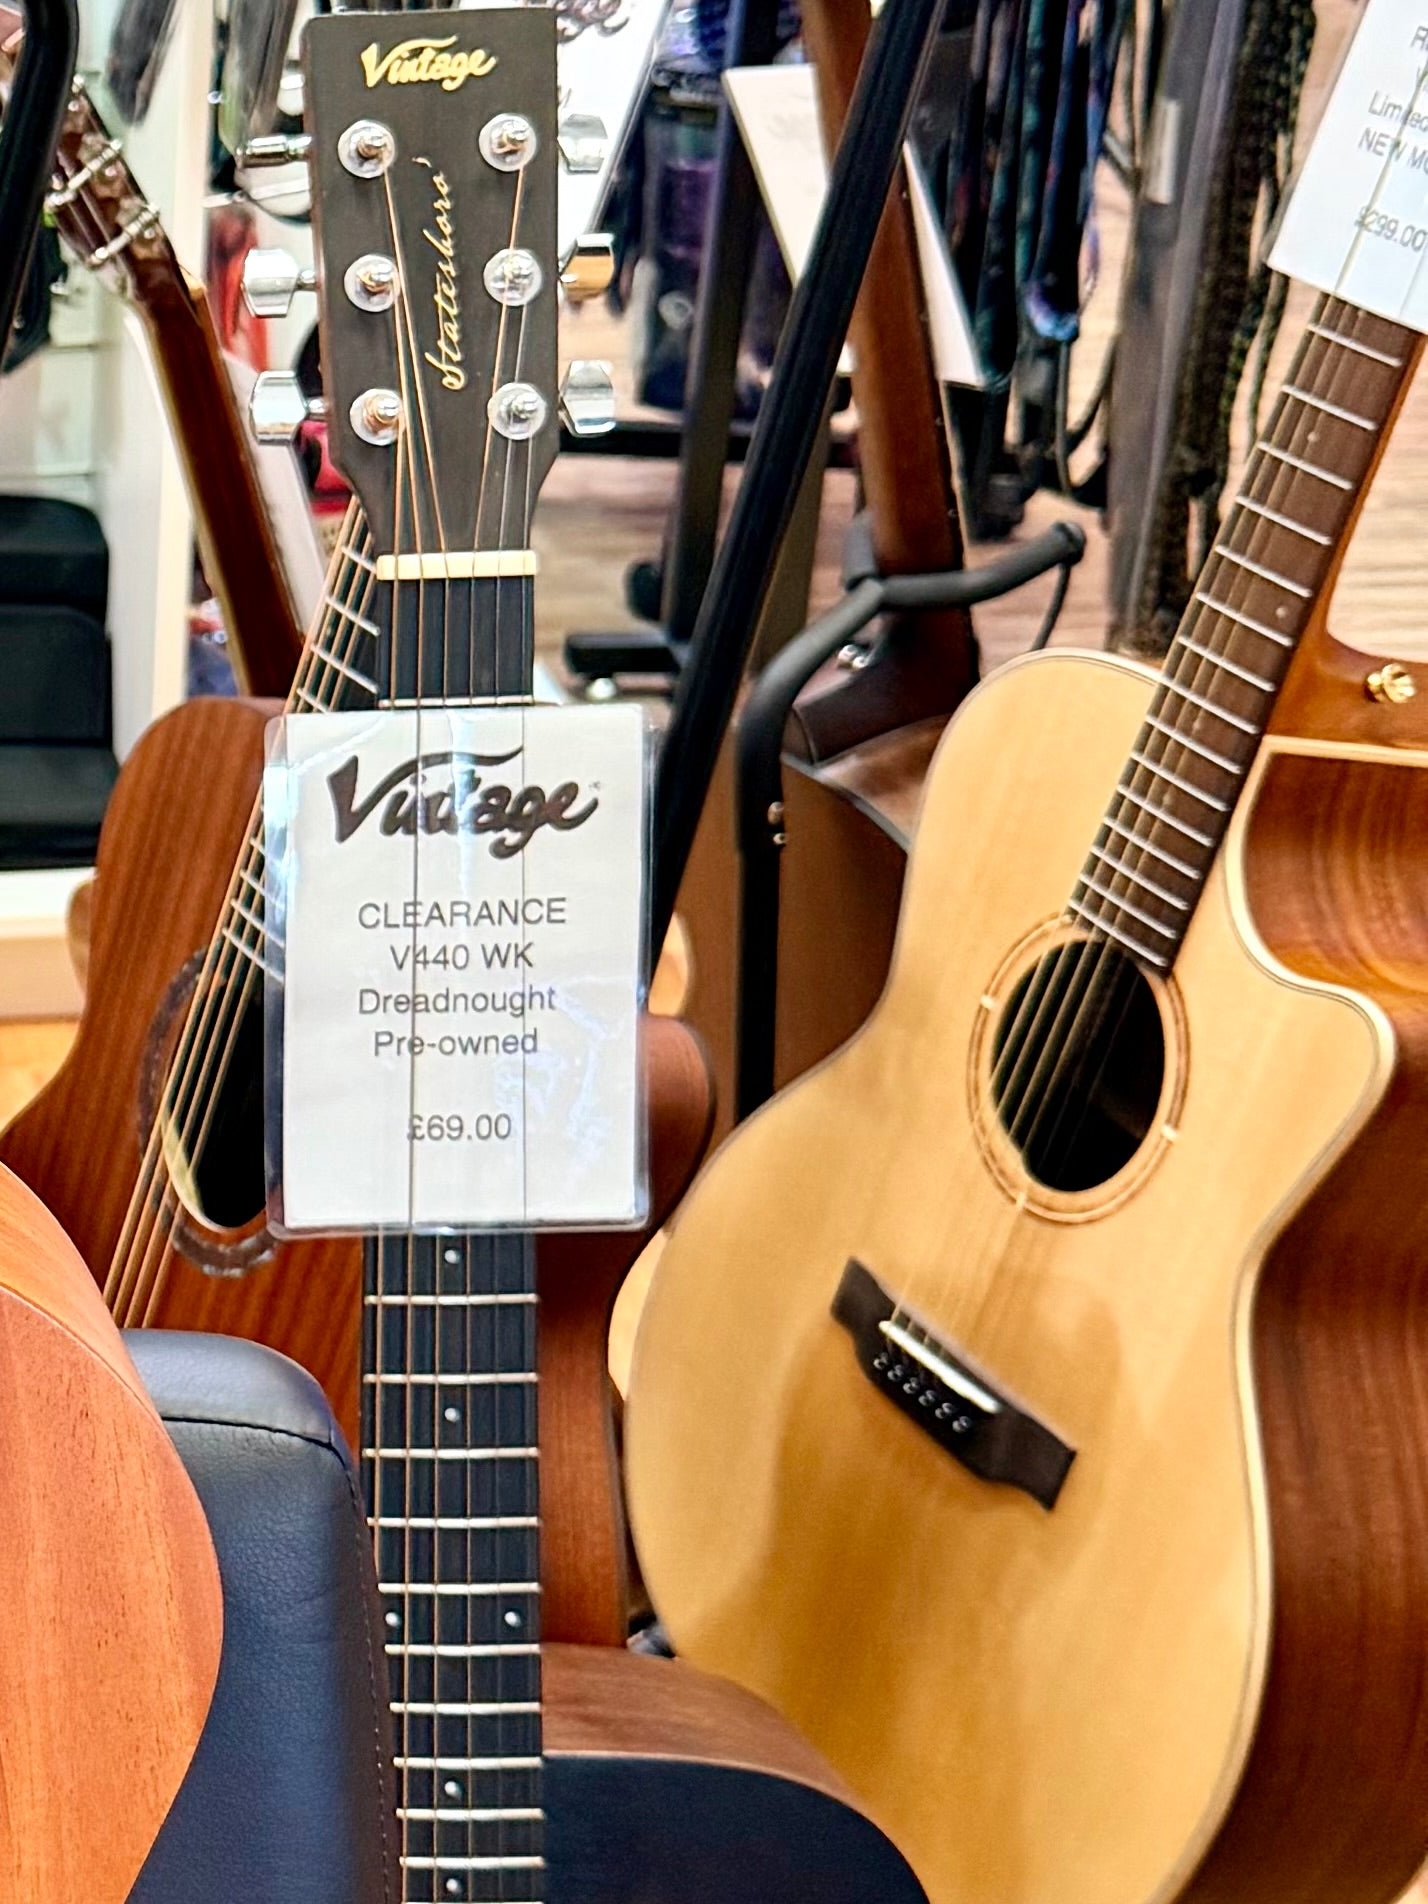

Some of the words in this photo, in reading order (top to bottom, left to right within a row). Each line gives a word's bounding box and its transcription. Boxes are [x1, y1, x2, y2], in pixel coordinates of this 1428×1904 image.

[359, 34, 498, 92] Vintage
[327, 744, 600, 860] Vintage
[358, 897, 568, 930] CLEARANCE
[390, 944, 471, 972] V440
[479, 942, 535, 971] WK
[358, 986, 557, 1019] Dreadnought
[373, 1028, 539, 1058] Pre-owned
[407, 1112, 513, 1142] £69.00
